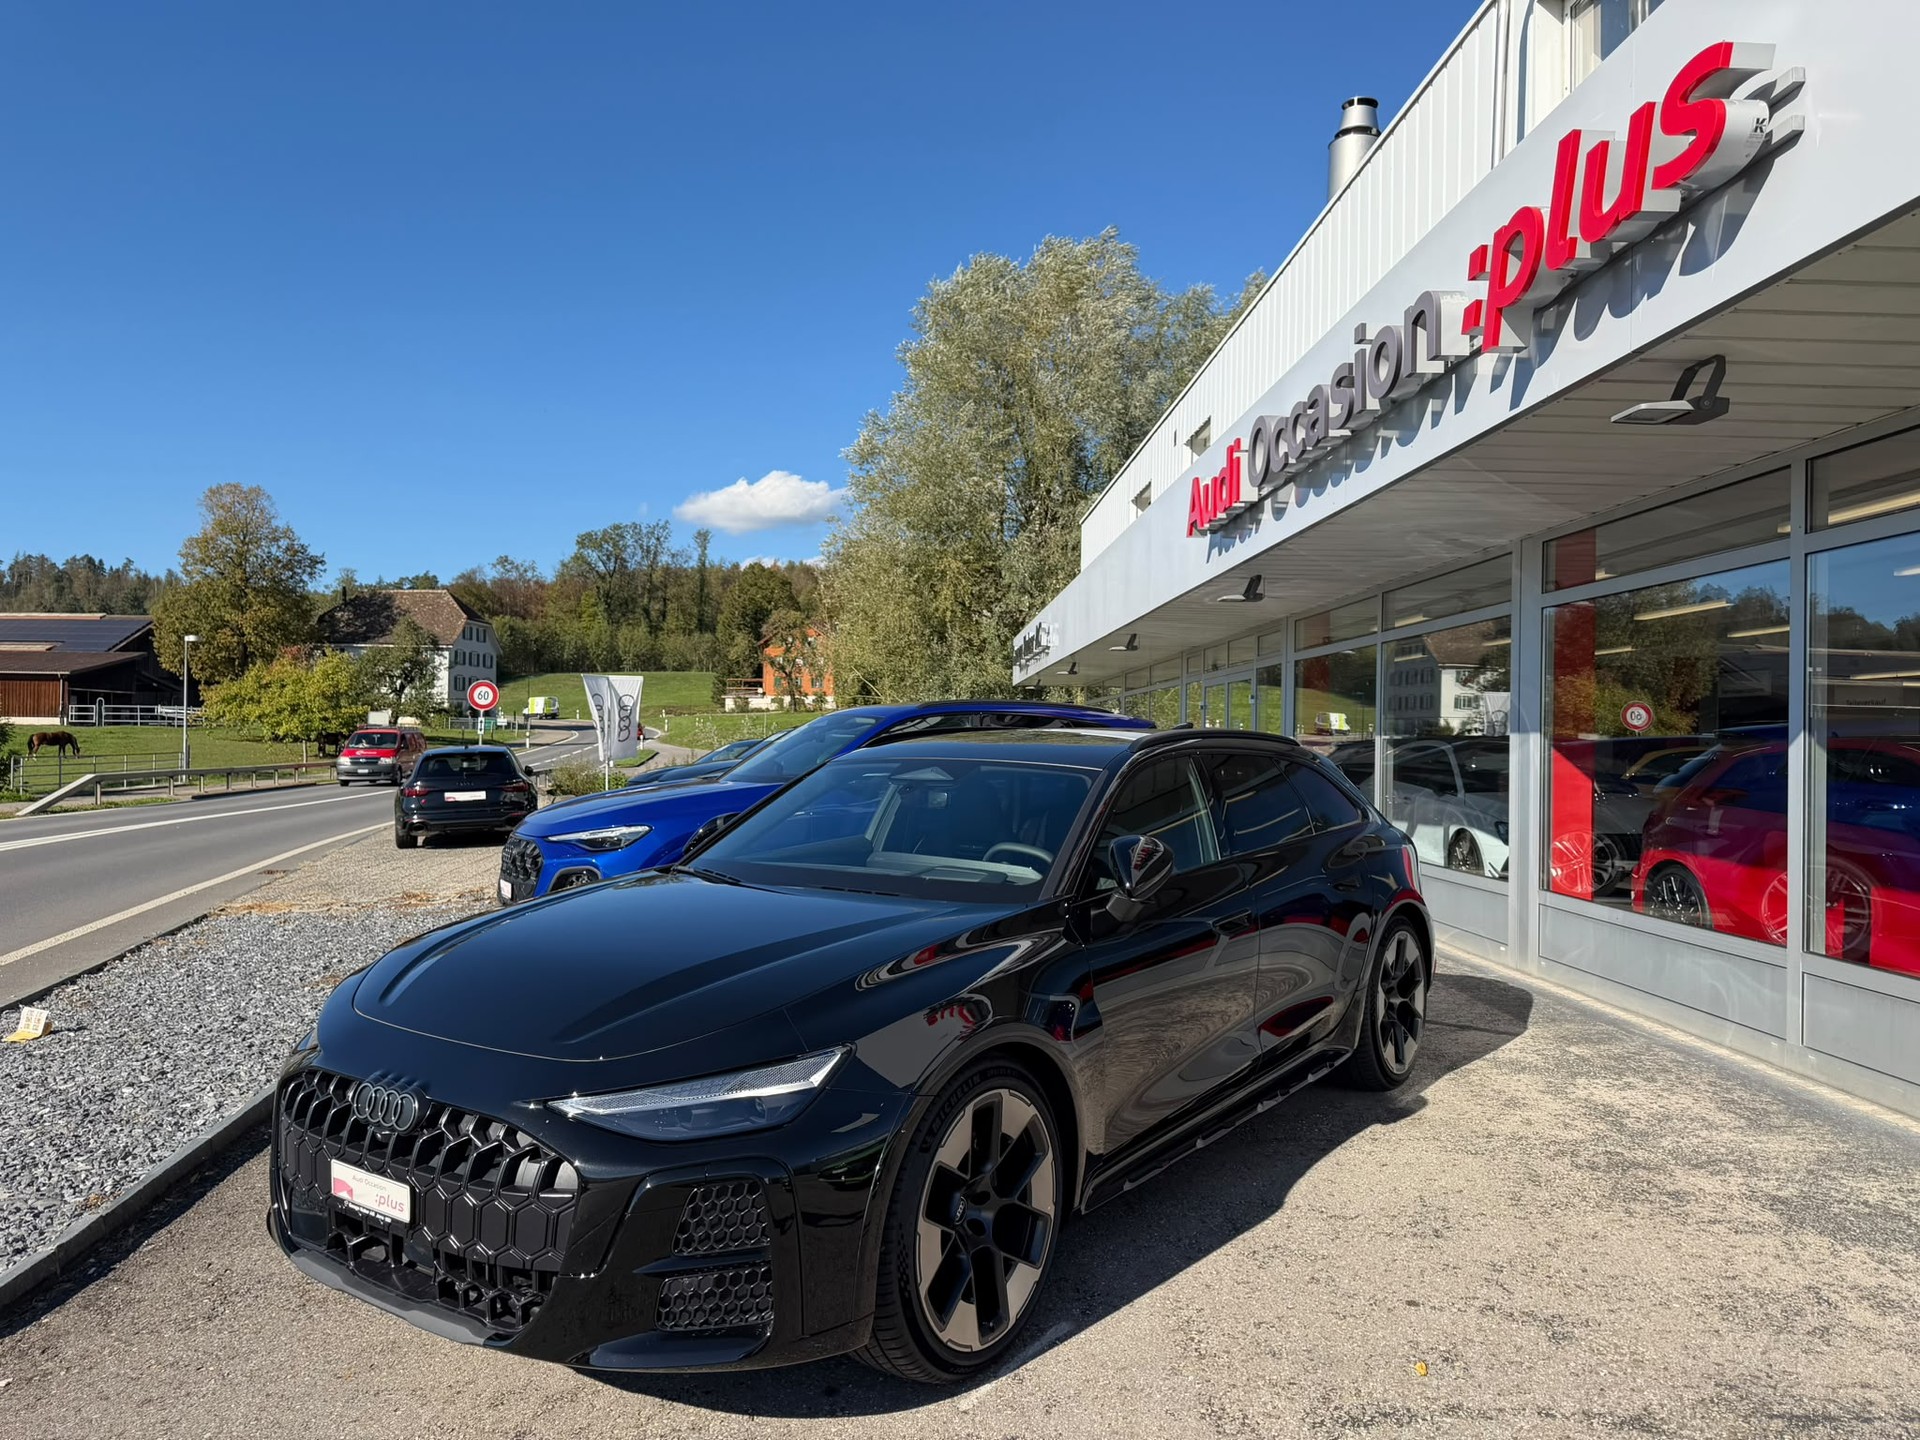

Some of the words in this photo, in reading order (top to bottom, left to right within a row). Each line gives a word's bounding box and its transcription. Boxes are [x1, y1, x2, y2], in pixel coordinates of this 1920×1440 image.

[1187, 438, 1241, 537] Audi
[1248, 290, 1442, 488] Occasion
[477, 690, 490, 701] 60
